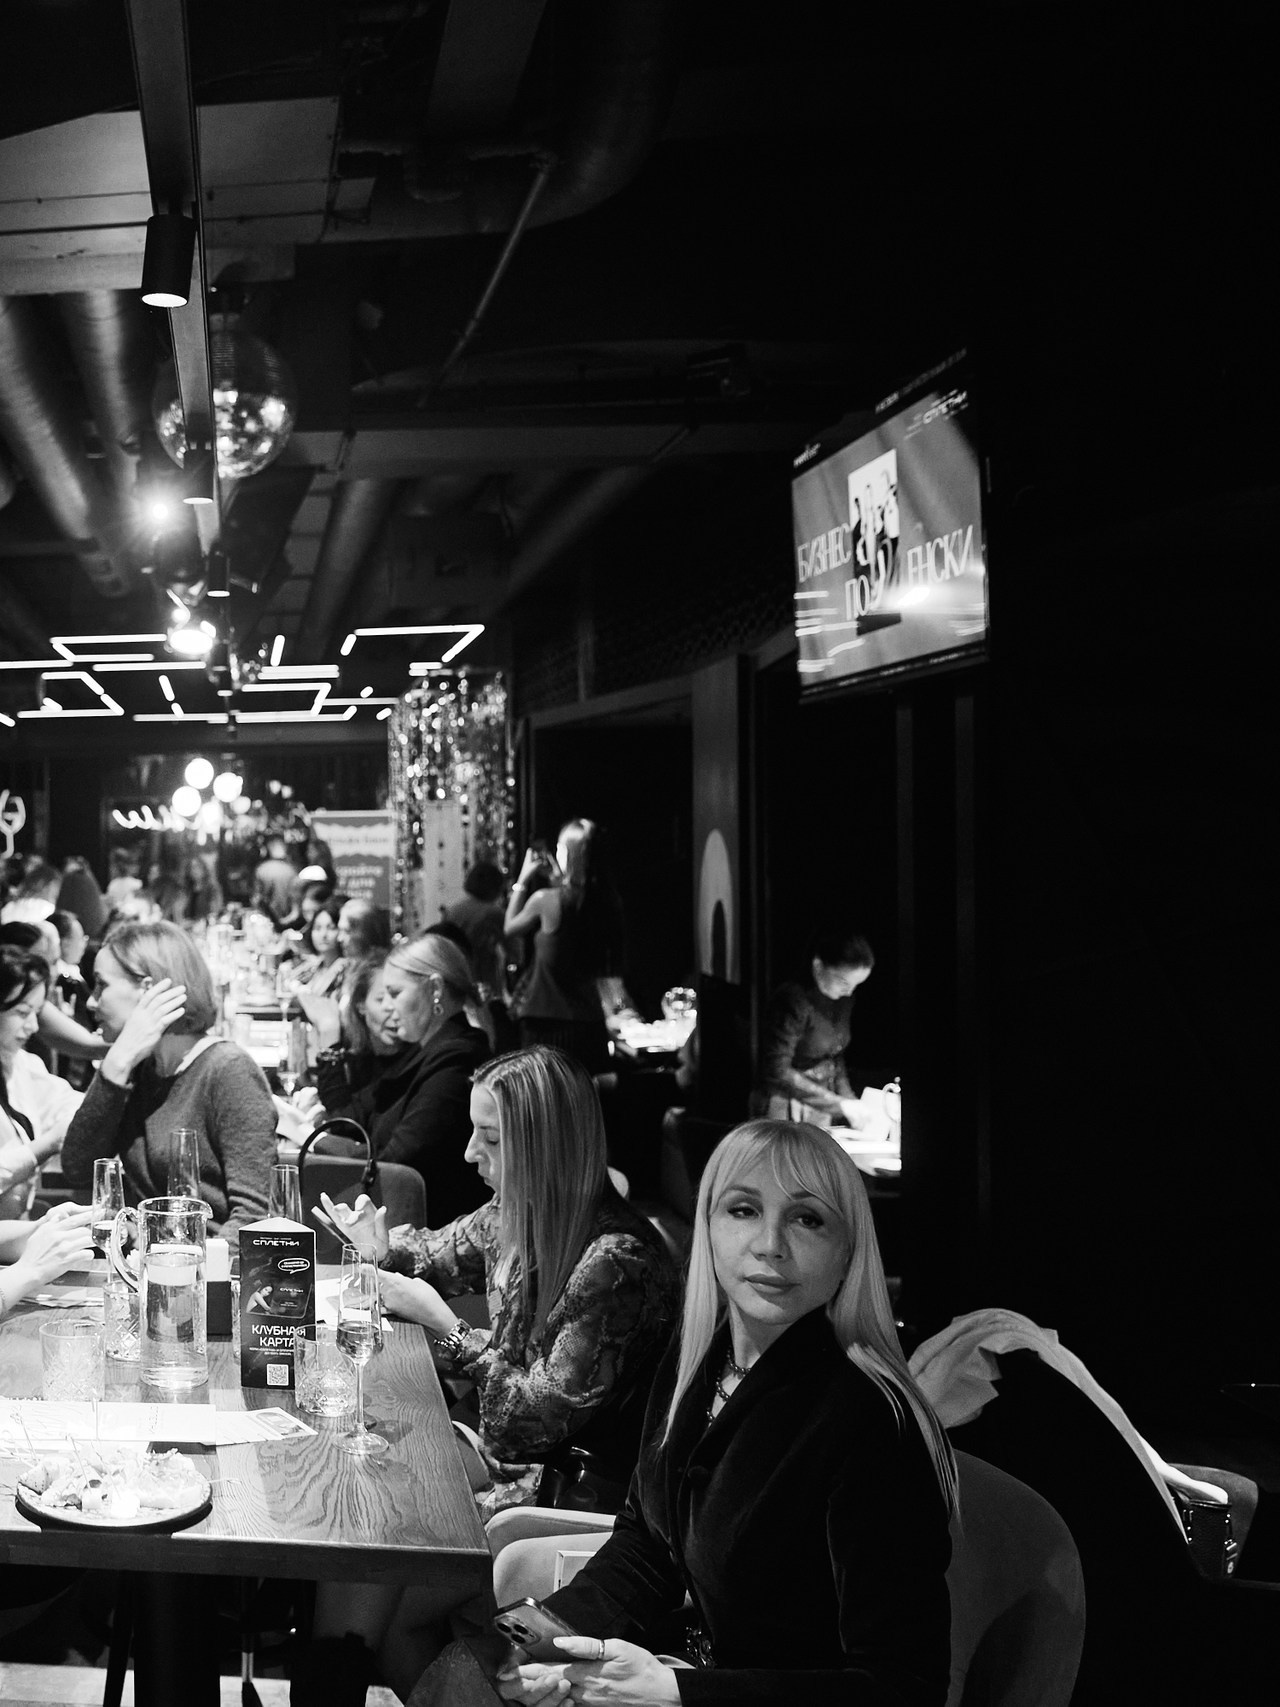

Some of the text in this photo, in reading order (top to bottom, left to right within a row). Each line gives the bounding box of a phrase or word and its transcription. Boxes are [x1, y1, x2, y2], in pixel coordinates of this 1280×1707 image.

[797, 523, 852, 582] БИЗНЕС
[251, 1324, 306, 1337] КЛУБНАЯ
[259, 1336, 295, 1348] КАРТА
